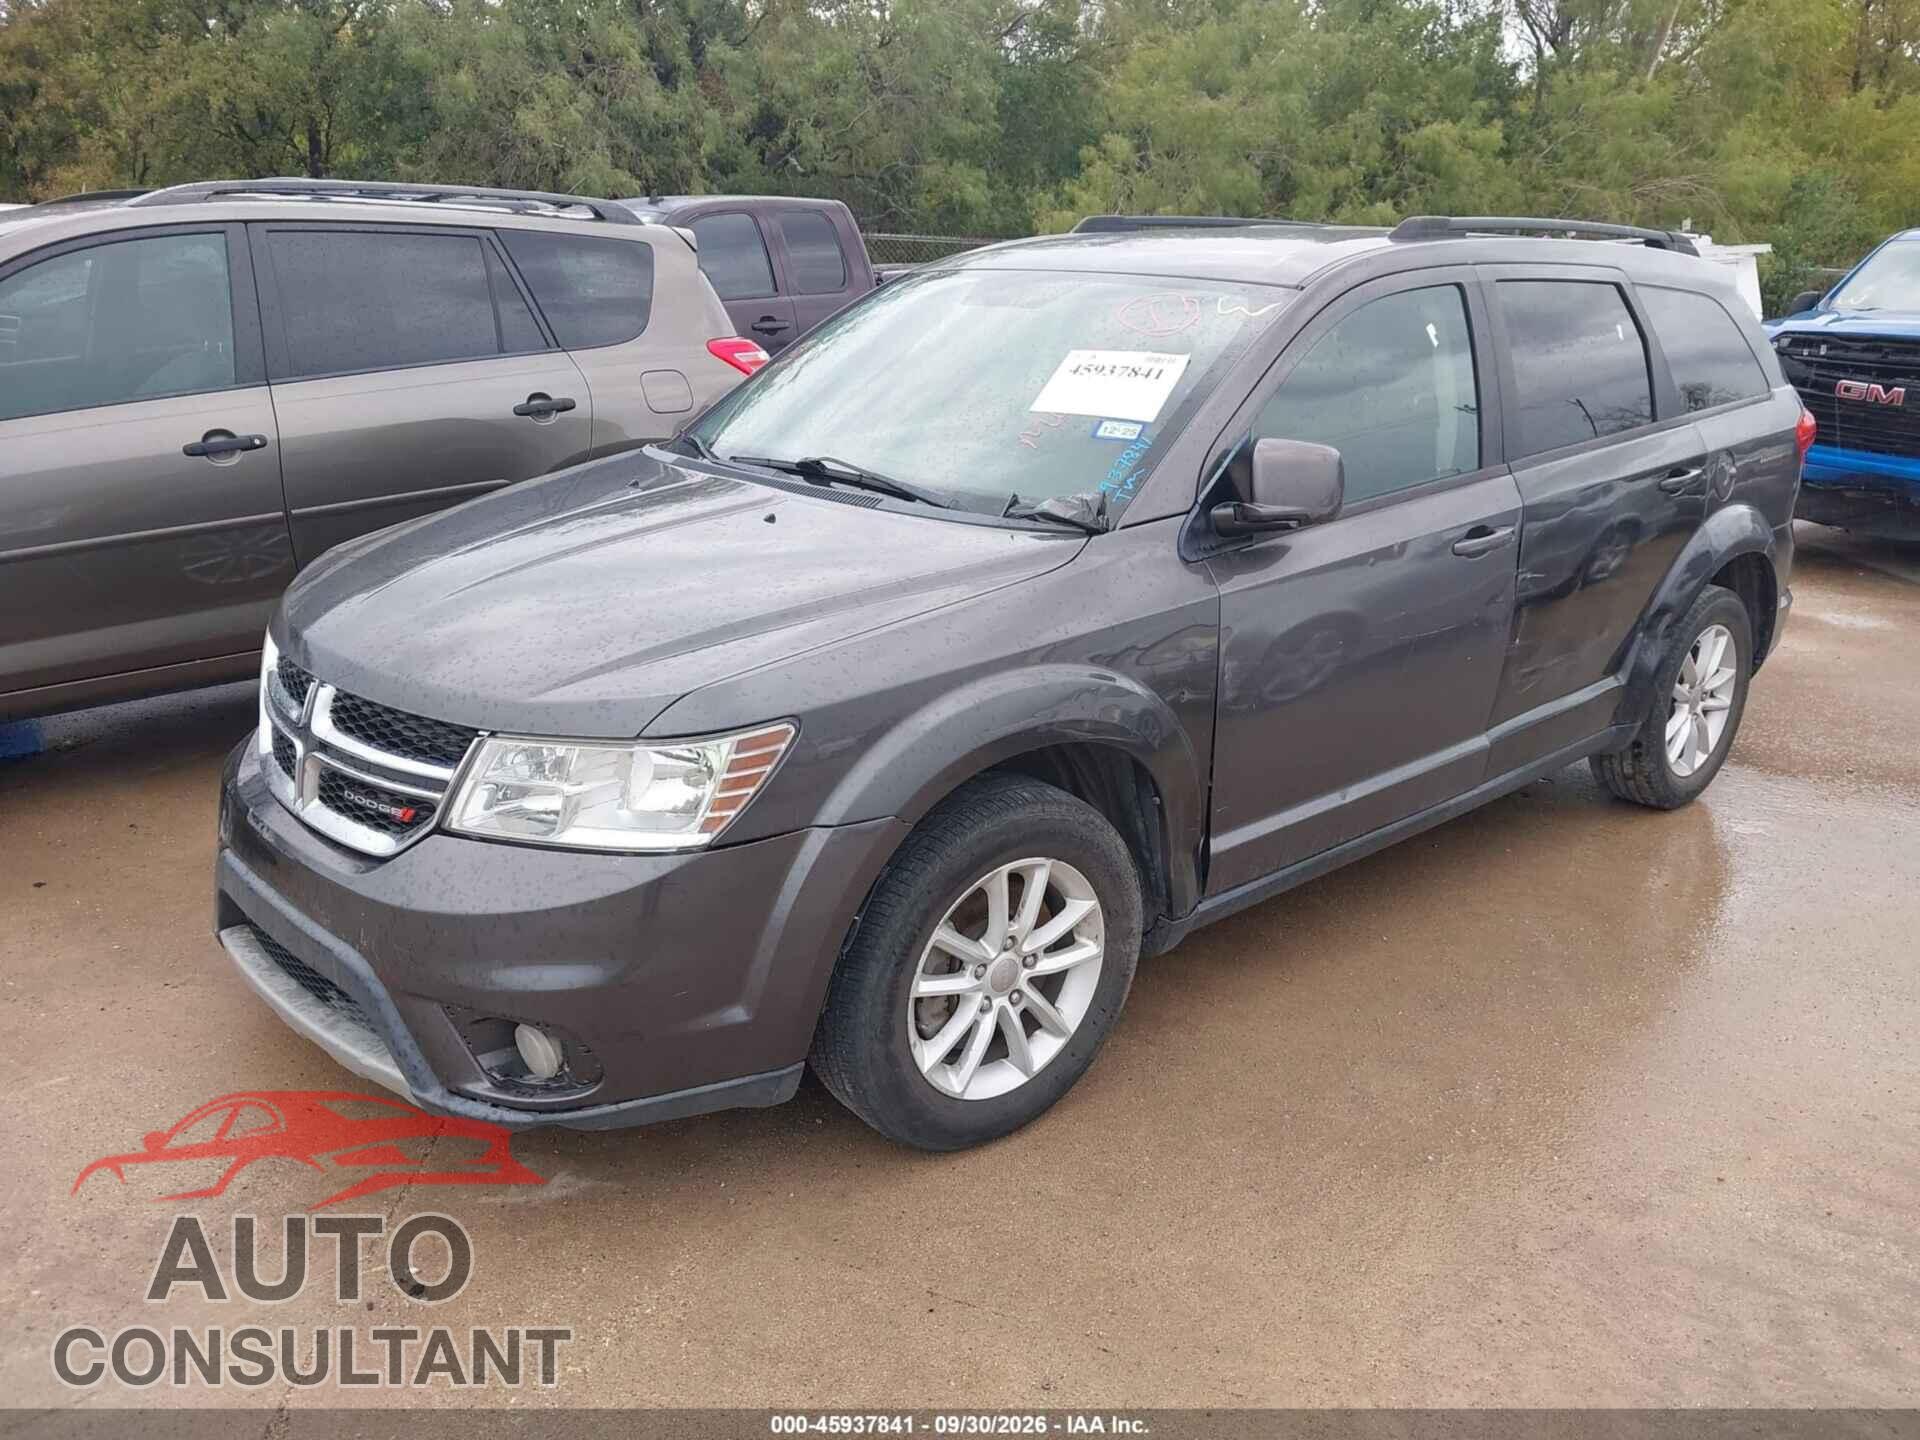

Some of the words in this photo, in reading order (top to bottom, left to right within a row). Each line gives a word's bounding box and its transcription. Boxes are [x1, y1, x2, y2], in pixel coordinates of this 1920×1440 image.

[1069, 363, 1165, 380] 45937841
[1835, 379, 1906, 406] GM
[344, 790, 401, 817] DODGE
